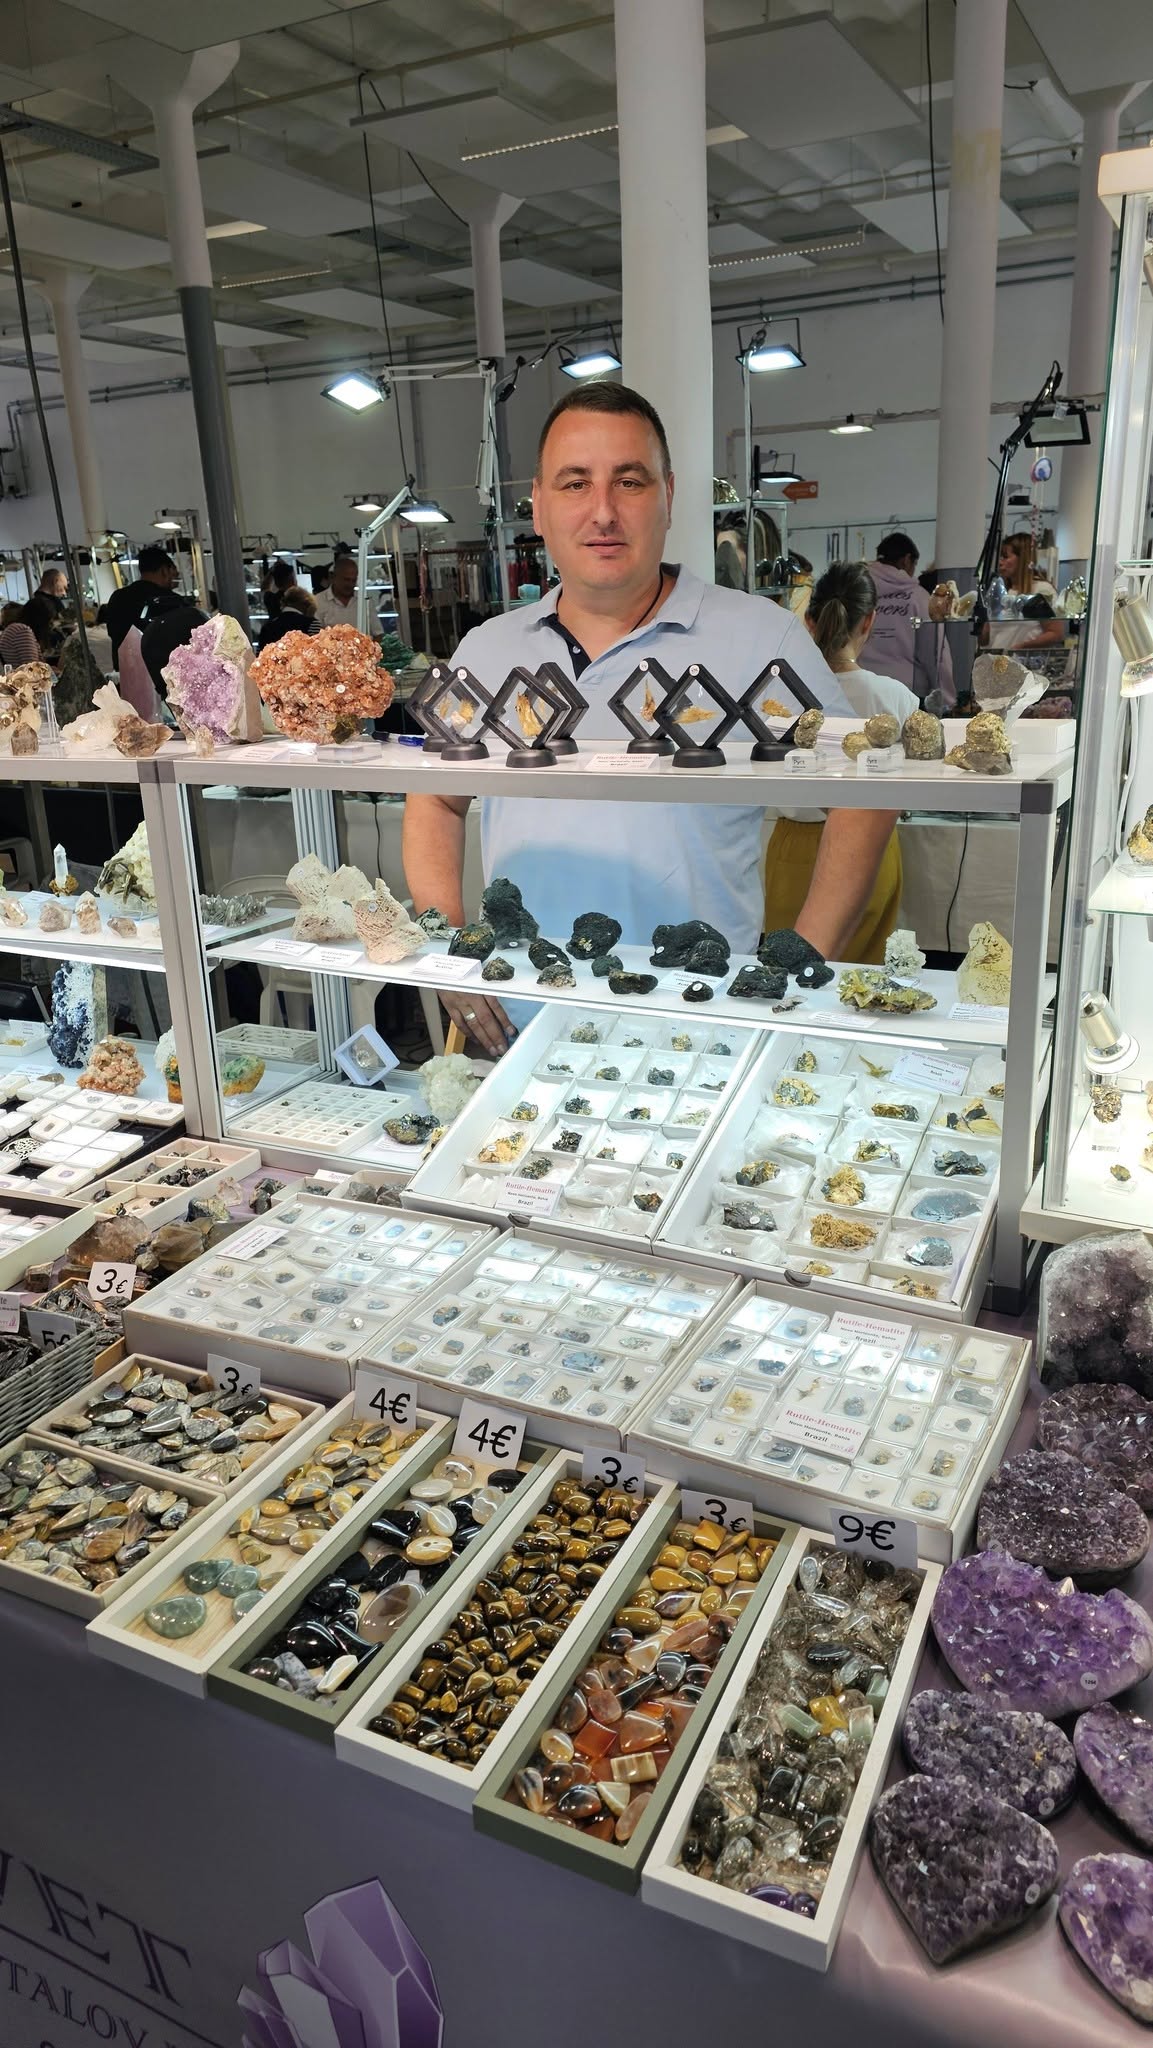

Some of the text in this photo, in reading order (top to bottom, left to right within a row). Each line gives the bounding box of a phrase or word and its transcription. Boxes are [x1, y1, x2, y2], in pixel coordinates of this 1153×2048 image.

[505, 1182, 556, 1195] Rutile-Hematite
[96, 1268, 128, 1294] 3€
[837, 1317, 906, 1336] Rutile-Hematite
[369, 1387, 411, 1425] 4€
[785, 1409, 862, 1437] Rutile-Hematite
[804, 1431, 828, 1443] Brazil
[468, 1417, 517, 1459] 4€
[595, 1456, 639, 1494] 3€
[838, 1515, 896, 1551] 9€
